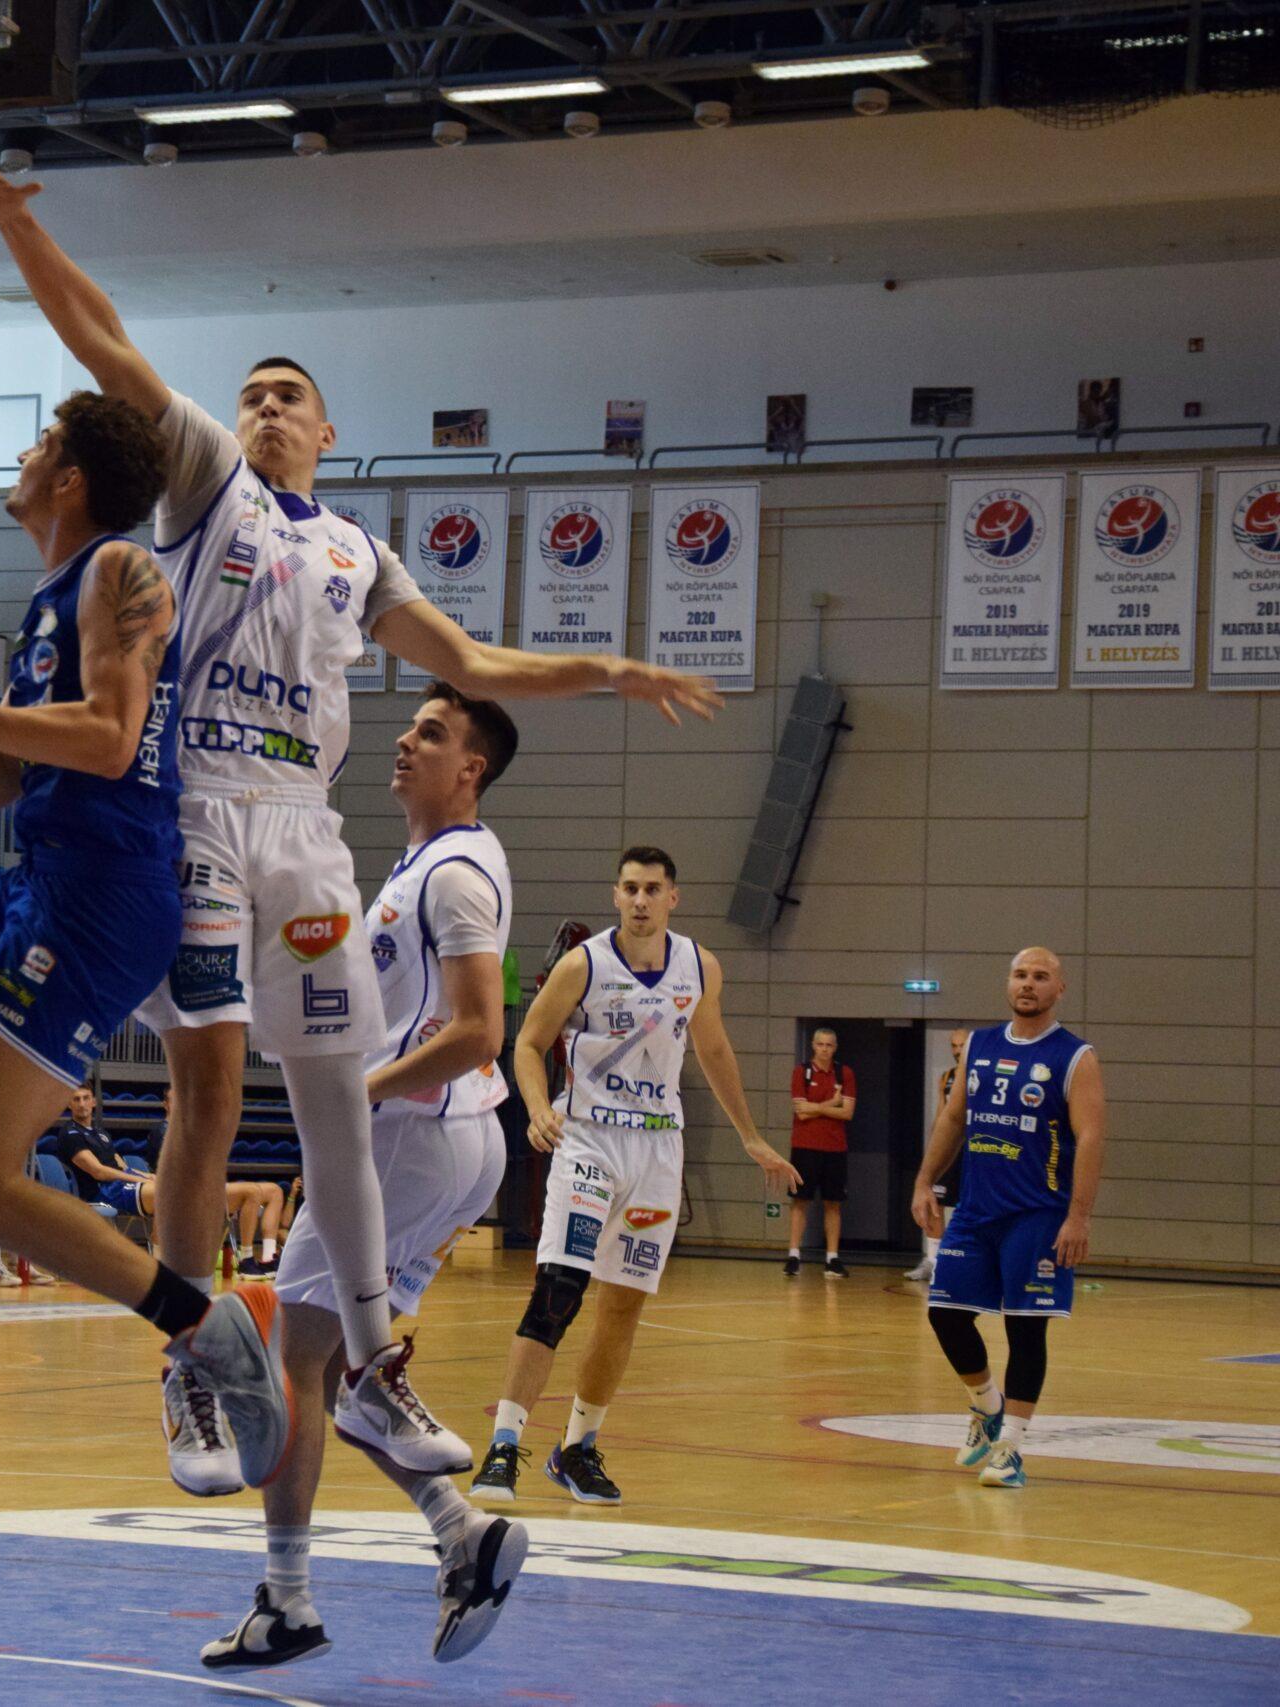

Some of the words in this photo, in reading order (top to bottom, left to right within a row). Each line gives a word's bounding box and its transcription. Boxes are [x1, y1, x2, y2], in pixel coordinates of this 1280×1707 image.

[1238, 483, 1280, 514] FATU
[545, 505, 593, 532] FATUM
[671, 501, 720, 530] FATUM
[978, 586, 1026, 596] CSAPATA
[1110, 584, 1160, 595] CSAPATA
[431, 596, 473, 605] CSAPATA
[552, 594, 595, 604] CSAPATA
[679, 593, 724, 603] CSAPATA
[986, 604, 1018, 619] 2019
[1118, 603, 1151, 619] 2019
[1256, 601, 1280, 617] 201
[559, 612, 586, 627] 2021
[686, 611, 716, 626] 2020
[952, 624, 993, 638] MAGYAR
[1086, 624, 1142, 638] MAGYAR
[1144, 623, 1181, 637] KUPA
[1221, 622, 1264, 636] MAGYAR
[532, 631, 579, 644] MAGYAR
[581, 631, 613, 643] KUPA
[659, 631, 708, 644] MAGYAR
[710, 630, 743, 643] KUPA
[672, 648, 745, 667] HELYEZÉS
[952, 647, 968, 662] II.
[971, 642, 1048, 662] HELYEZÉS
[1085, 647, 1097, 662] I.
[1099, 641, 1181, 662] HELYEZÉS
[1221, 647, 1238, 662] II.
[179, 861, 212, 889] JE
[292, 921, 334, 940] MOL
[372, 945, 398, 961] KTE
[603, 1011, 635, 1029] 18
[991, 1077, 1010, 1106] 3
[618, 1232, 661, 1271] 18
